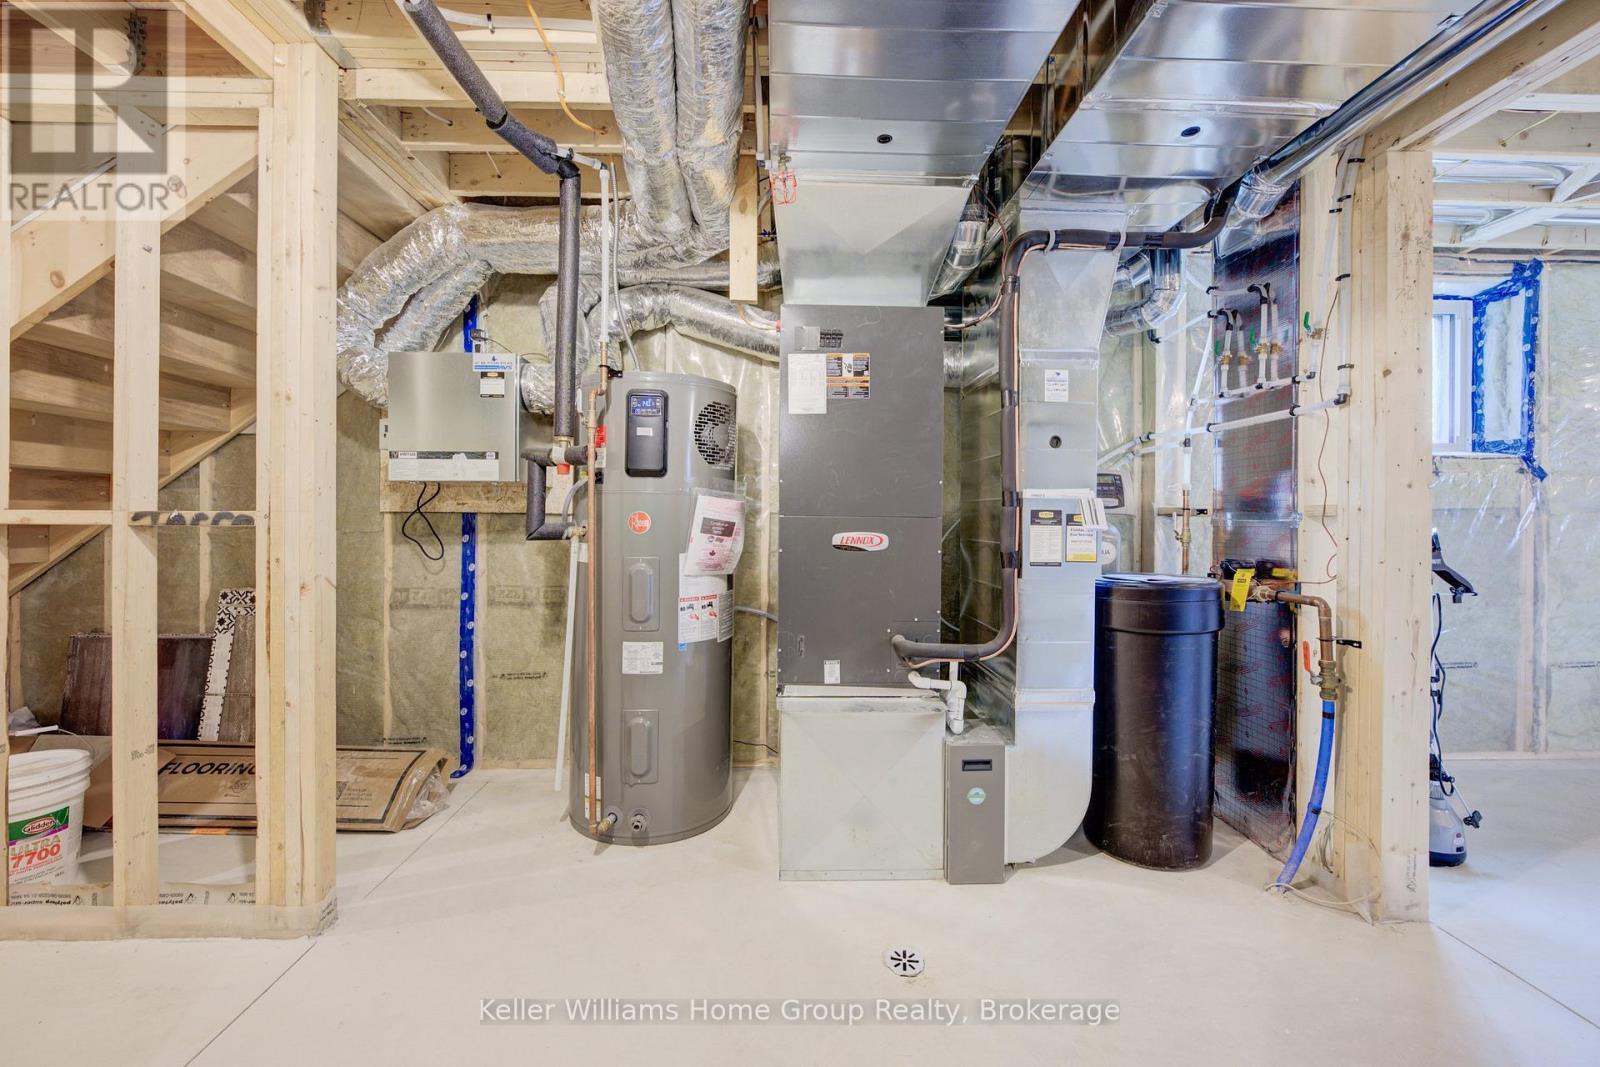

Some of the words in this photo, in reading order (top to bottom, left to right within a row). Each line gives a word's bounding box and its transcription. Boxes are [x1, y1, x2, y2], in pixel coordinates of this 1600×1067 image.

[840, 535, 875, 545] LENNOX
[23, 819, 56, 832] Glidden
[10, 843, 61, 869] 7700
